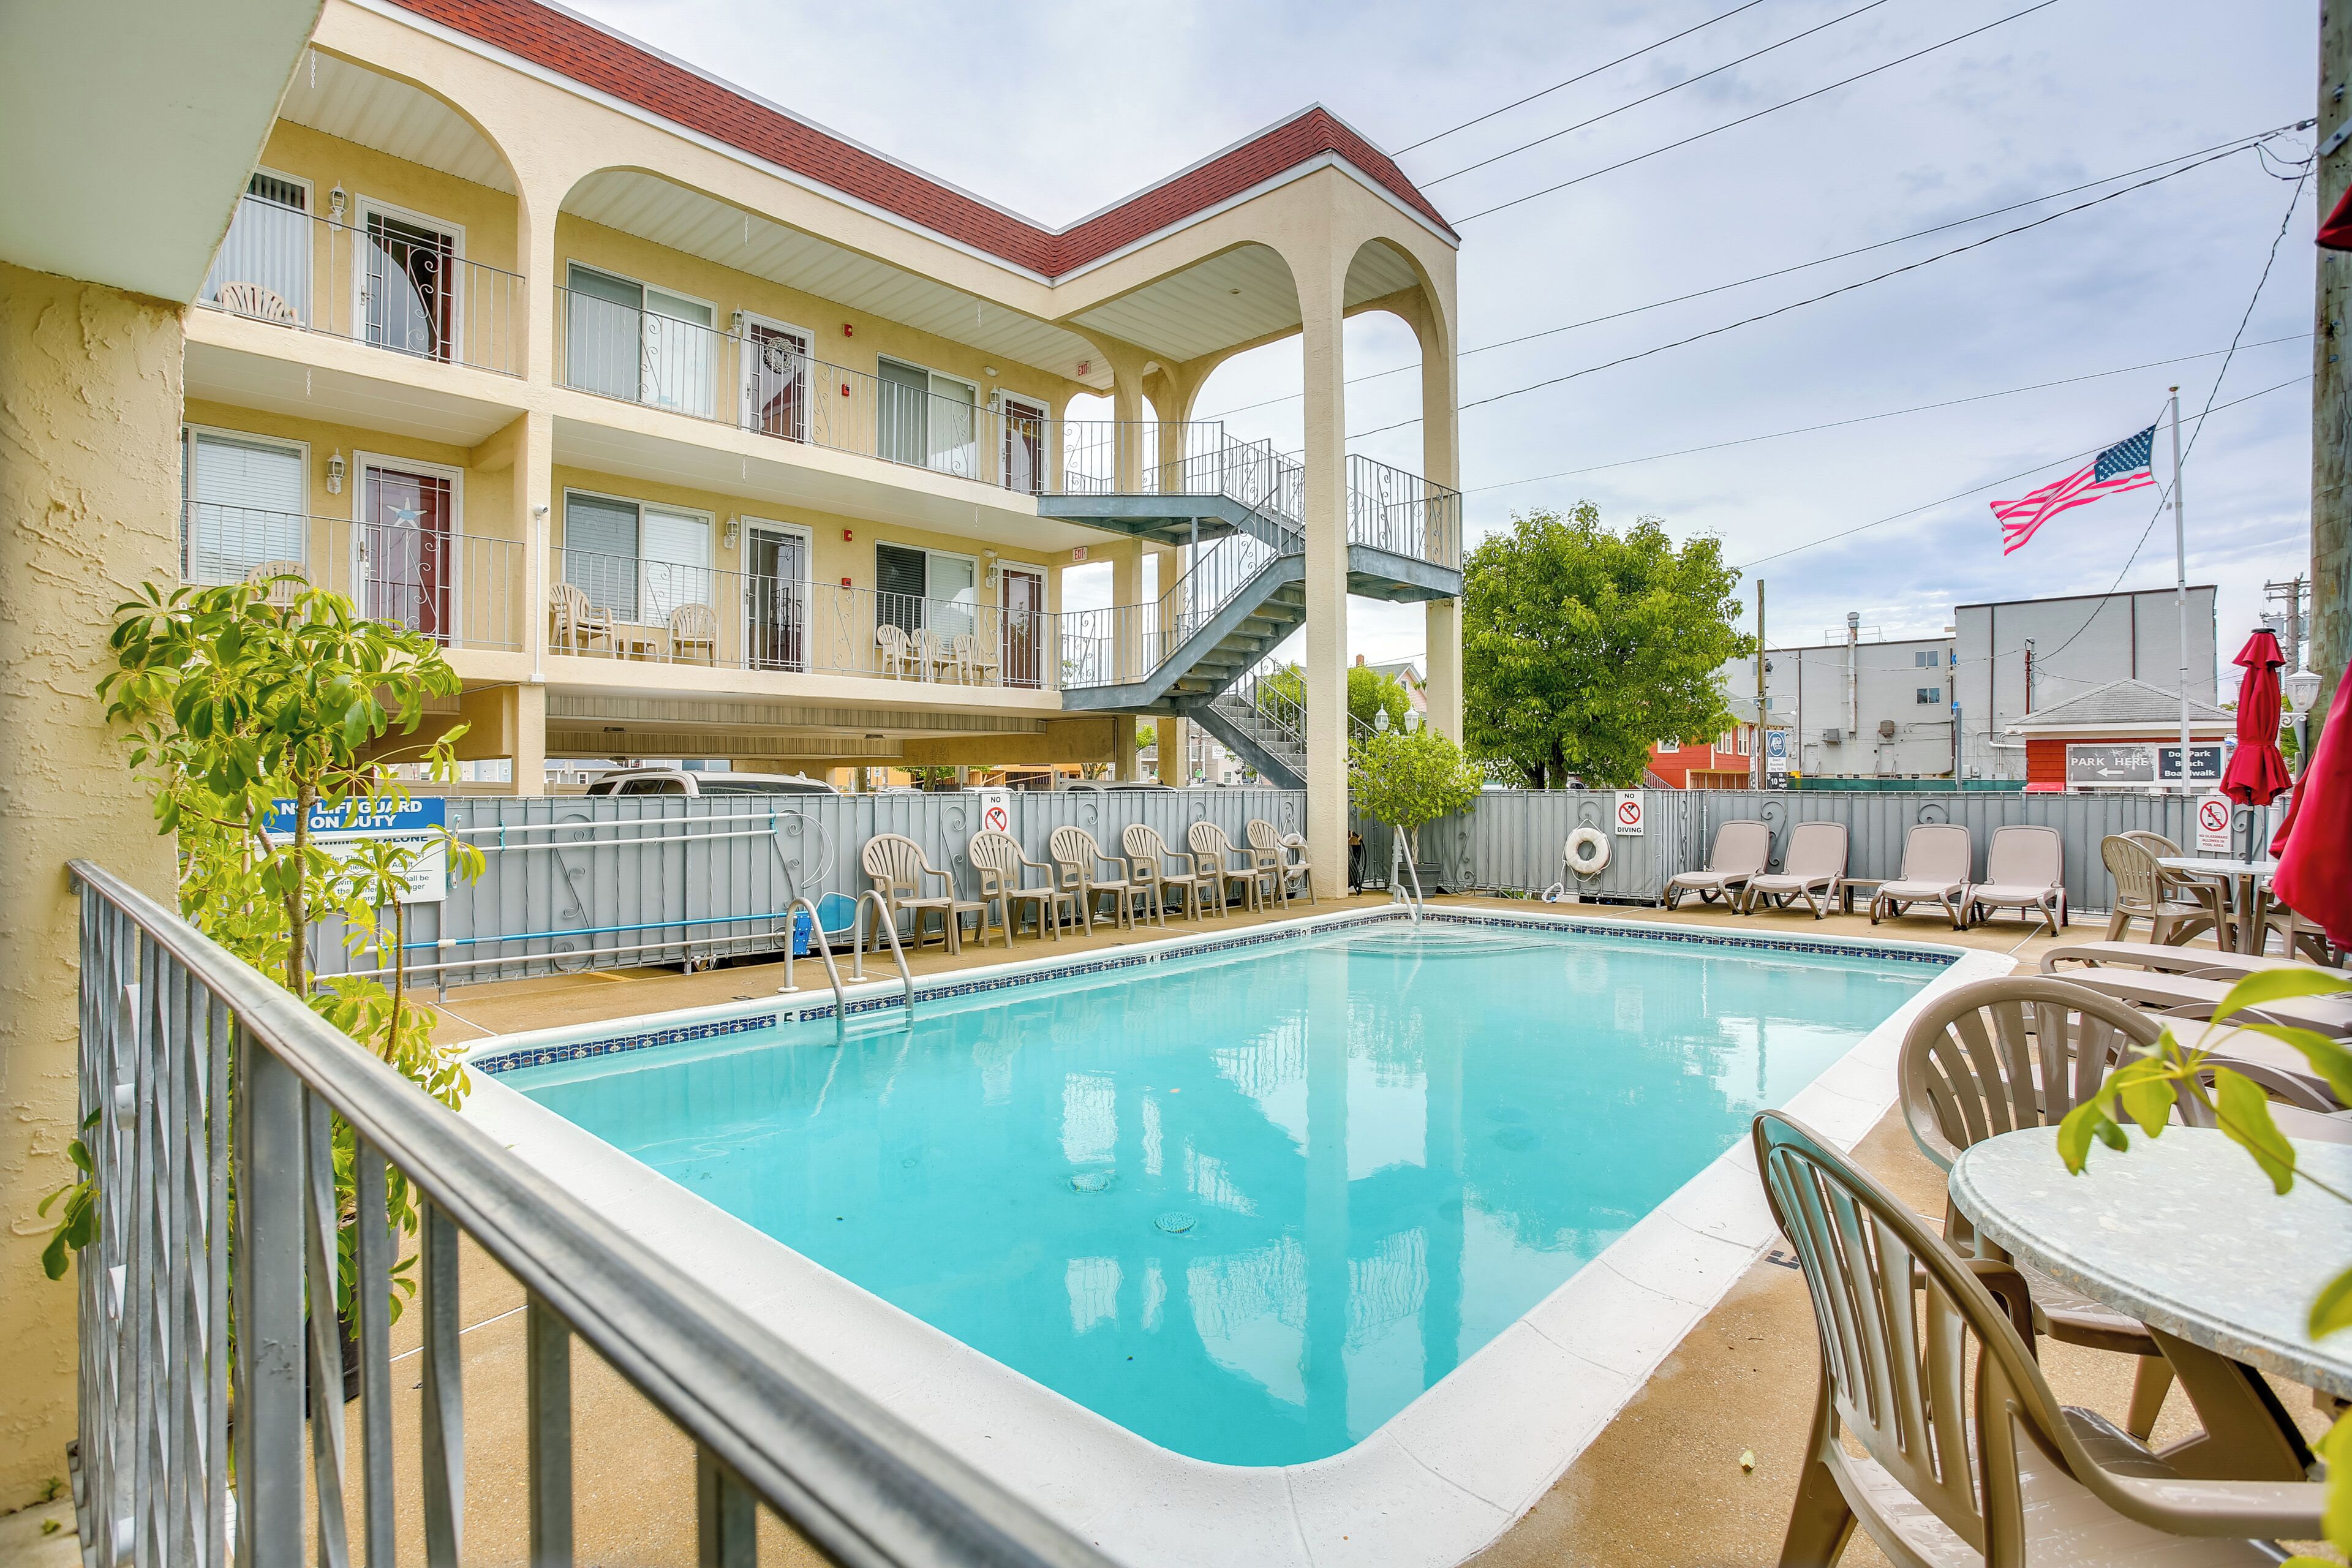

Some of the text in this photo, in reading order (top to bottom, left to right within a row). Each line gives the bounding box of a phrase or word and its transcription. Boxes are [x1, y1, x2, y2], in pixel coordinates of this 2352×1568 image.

[1078, 364, 1087, 376] EXIT
[1074, 548, 1084, 559] EXIT
[2071, 757, 2147, 766] PARK HERE
[310, 816, 339, 829] ON
